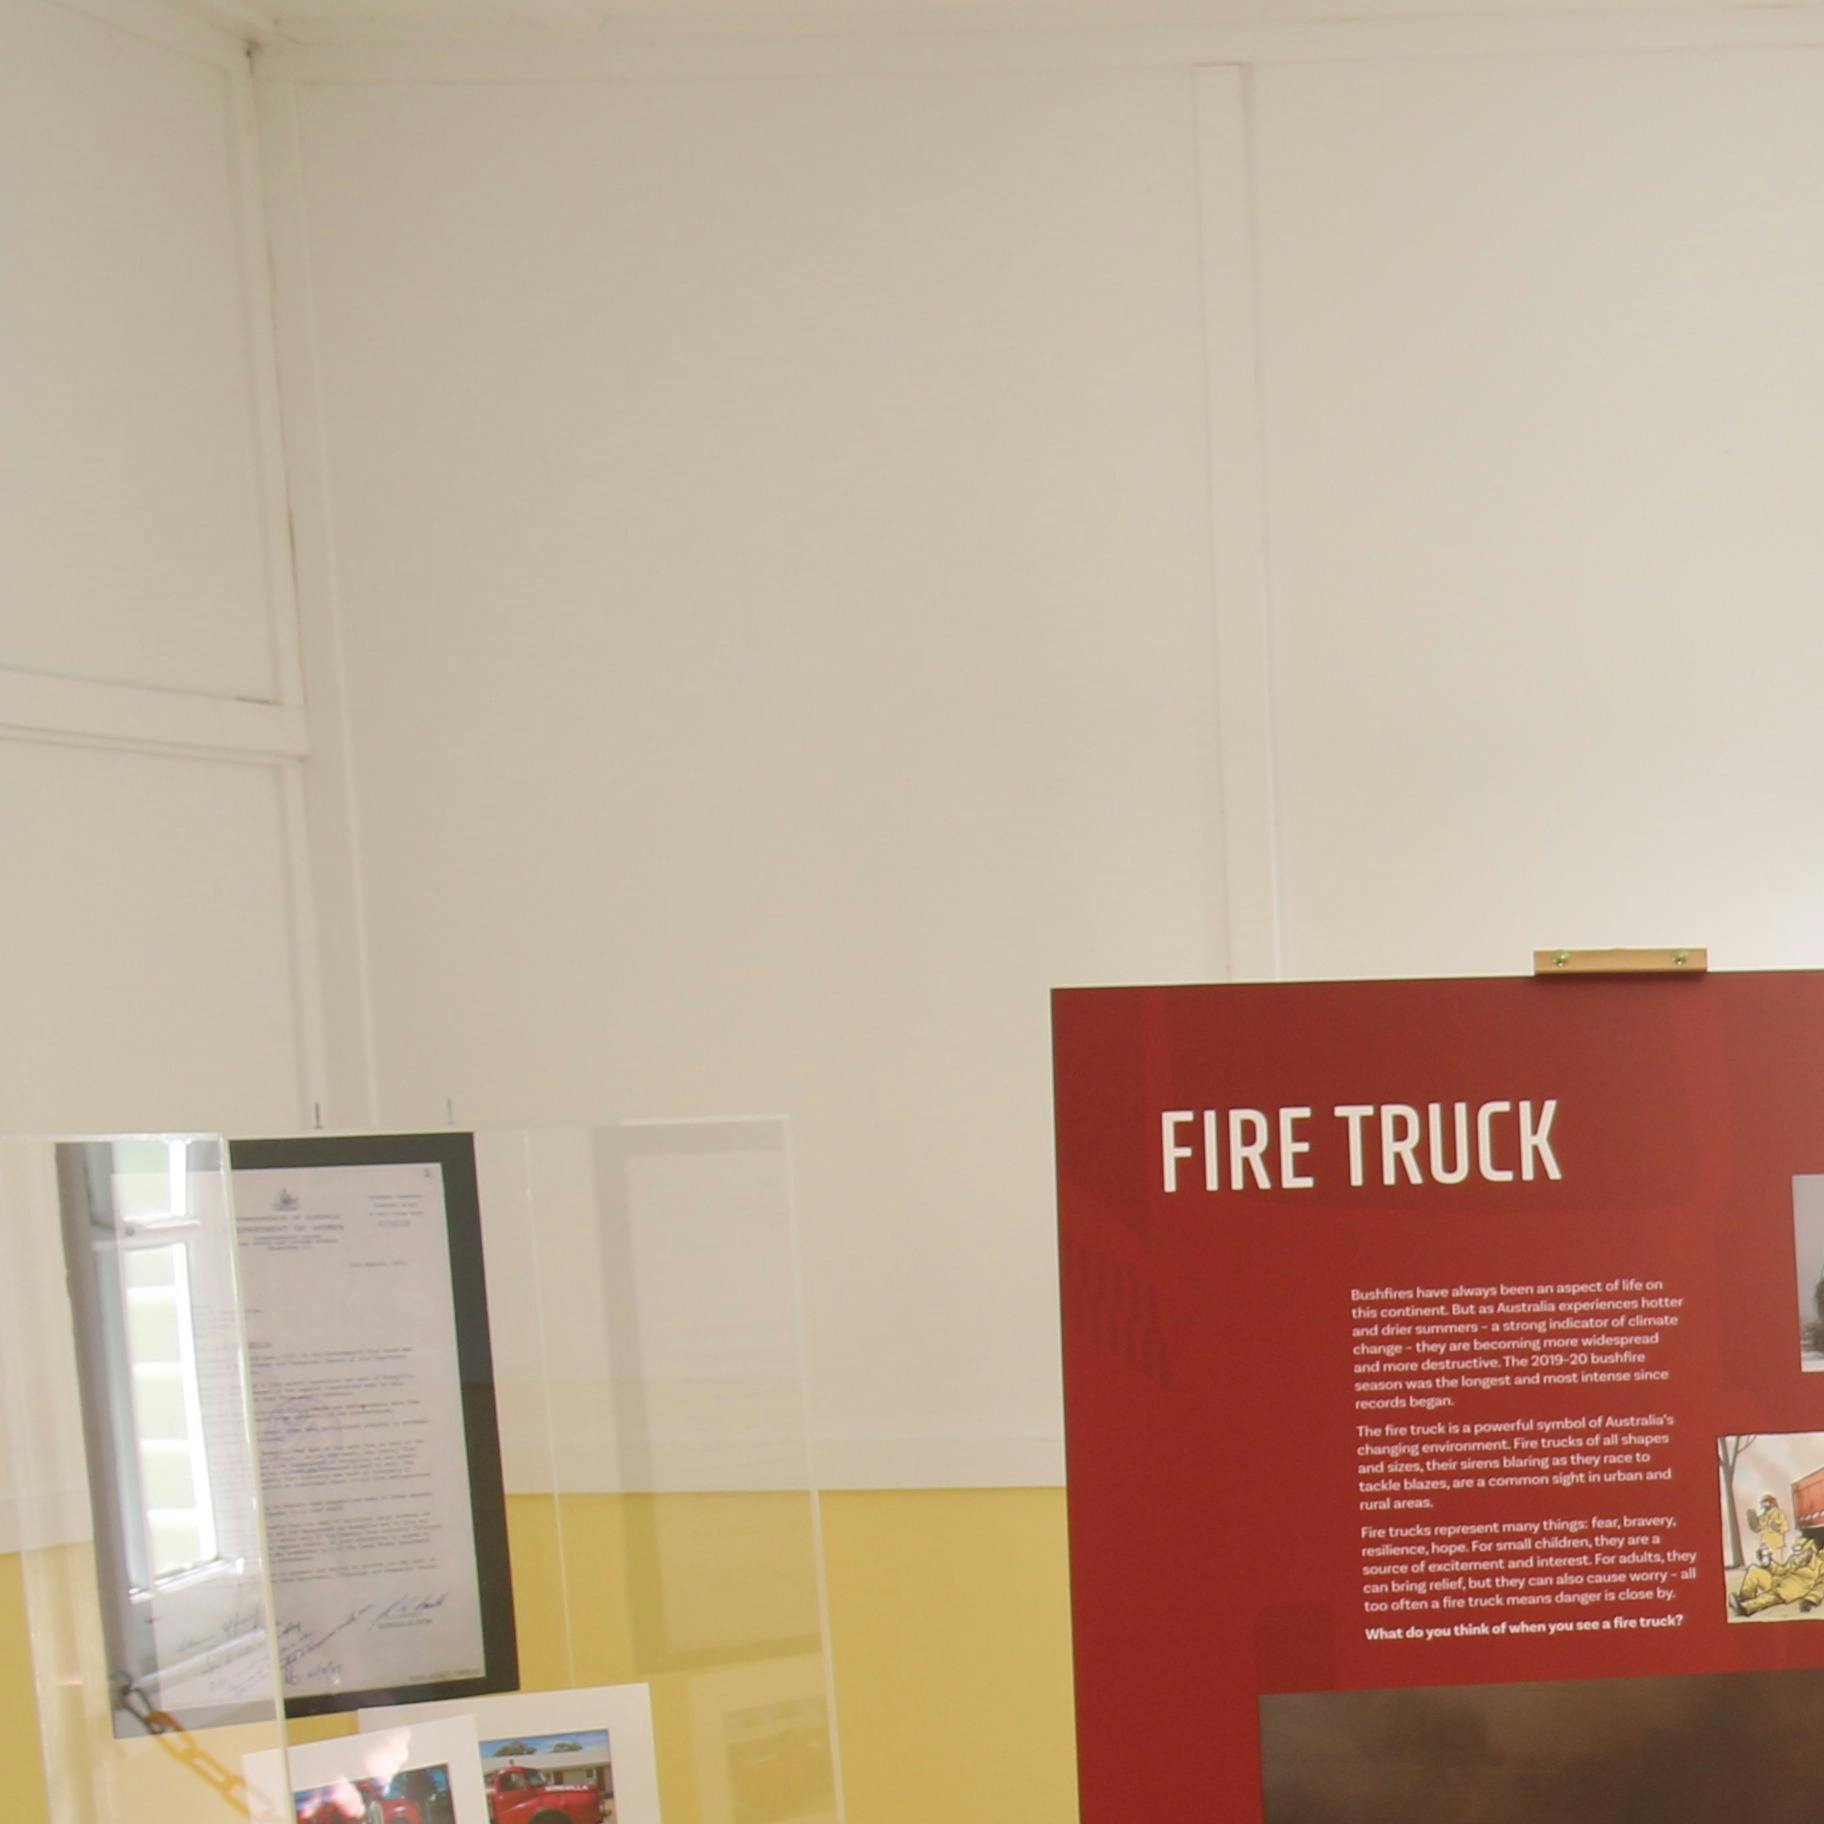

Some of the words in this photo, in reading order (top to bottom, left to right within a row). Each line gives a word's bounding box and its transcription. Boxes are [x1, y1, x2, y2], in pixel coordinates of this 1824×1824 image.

[1161, 1106, 1315, 1193] FIRE
[1334, 1099, 1563, 1187] TRUCK
[1351, 1288, 1413, 1300] Bushfires
[1417, 1287, 1449, 1298] have
[1452, 1285, 1497, 1298] always
[1500, 1284, 1533, 1295] been
[1537, 1285, 1553, 1294] an
[1557, 1282, 1602, 1295] aspect
[1606, 1280, 1619, 1291] of
[1622, 1279, 1642, 1290] life
[1646, 1282, 1663, 1290] on
[1352, 1307, 1377, 1319] this
[1452, 1304, 1475, 1315] But
[1479, 1305, 1494, 1314] as
[1497, 1301, 1555, 1313] Australia
[1559, 1299, 1638, 1313] experiences
[1641, 1297, 1682, 1308] hotter
[1354, 1361, 1380, 1373] and
[1383, 1362, 1418, 1371] more
[1421, 1357, 1501, 1370] destructive.
[1503, 1356, 1528, 1367] The
[1591, 1351, 1645, 1364] bushfire
[1355, 1381, 1402, 1391] season
[1405, 1380, 1432, 1389] was
[1435, 1376, 1458, 1388] the
[1462, 1376, 1511, 1389] longest
[1514, 1373, 1540, 1385] and
[1543, 1373, 1578, 1384] most
[1582, 1371, 1630, 1382] intense
[1634, 1369, 1668, 1380] since
[1356, 1426, 1382, 1437] The
[1385, 1424, 1407, 1436] fire
[1410, 1423, 1445, 1435] truck
[1449, 1423, 1459, 1433] is
[1463, 1425, 1471, 1433] a
[1474, 1419, 1533, 1435] powerful
[1537, 1417, 1586, 1432] symbol
[1589, 1416, 1602, 1428] of
[1606, 1415, 1673, 1427] Australia's
[1357, 1443, 1419, 1457] changing
[1514, 1438, 1538, 1449] Fire
[1541, 1436, 1583, 1448] trucks
[1586, 1434, 1600, 1446] of
[1603, 1434, 1618, 1445] all
[1622, 1433, 1669, 1446] shapes
[1361, 1527, 1386, 1538] Fire
[1389, 1524, 1431, 1537] trucks
[1434, 1523, 1499, 1537] represent
[1503, 1523, 1540, 1534] many
[1543, 1519, 1587, 1532] things:
[1592, 1517, 1621, 1529] fear,
[1365, 1628, 1403, 1639] What
[1406, 1626, 1424, 1638] do
[1426, 1628, 1451, 1640] you
[1454, 1623, 1489, 1636] think
[1492, 1622, 1506, 1634] of
[1509, 1621, 1546, 1633] when
[1548, 1622, 1573, 1634] you
[1576, 1621, 1599, 1630] see
[1602, 1621, 1611, 1629] a
[1614, 1617, 1637, 1628] fire
[1640, 1614, 1683, 1627] truck?
